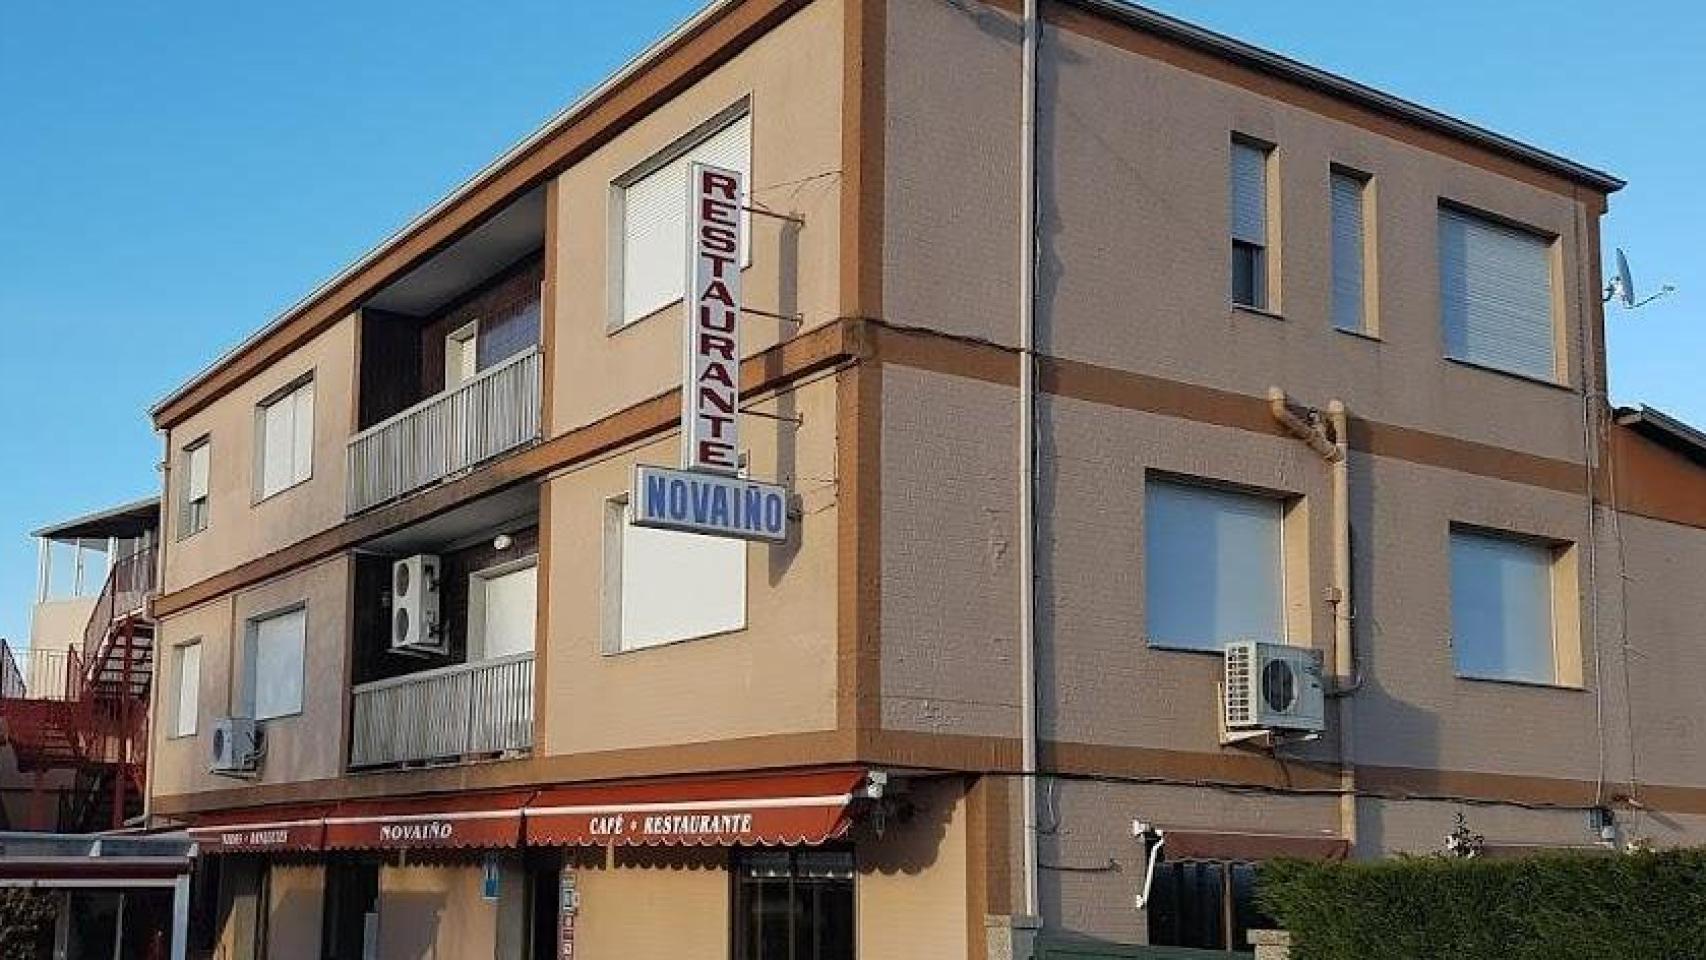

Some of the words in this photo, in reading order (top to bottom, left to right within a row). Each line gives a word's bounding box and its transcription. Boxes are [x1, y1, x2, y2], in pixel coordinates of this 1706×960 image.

[699, 171, 737, 466] RESTAURANTE
[647, 475, 782, 534] NOVAIÑO
[380, 821, 452, 840] NOVAIÑO
[589, 813, 623, 835] CAFÉ
[644, 813, 752, 835] RESTAURANTE
